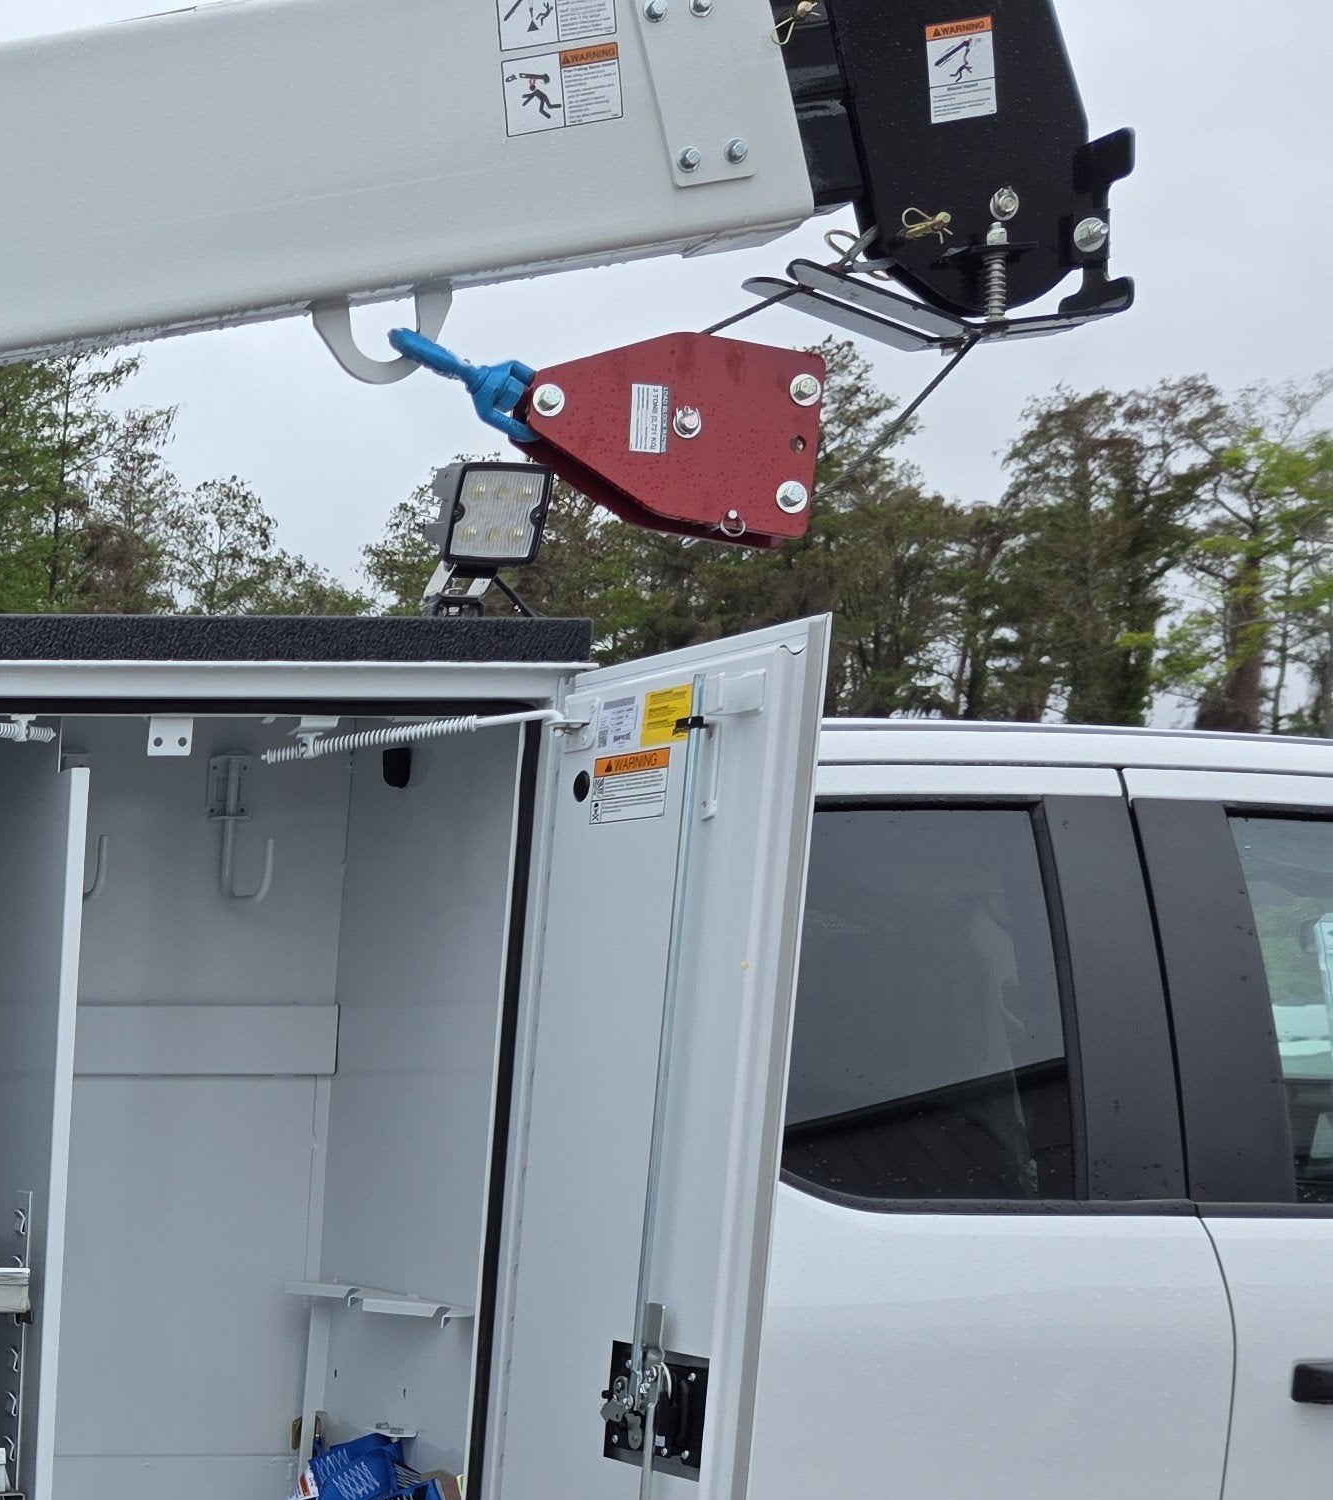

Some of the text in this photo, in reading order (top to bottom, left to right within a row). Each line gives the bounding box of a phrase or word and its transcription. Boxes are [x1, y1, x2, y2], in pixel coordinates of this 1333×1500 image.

[941, 21, 985, 35] WARNING
[571, 48, 615, 63] WARNING
[614, 752, 658, 772] WARNING
